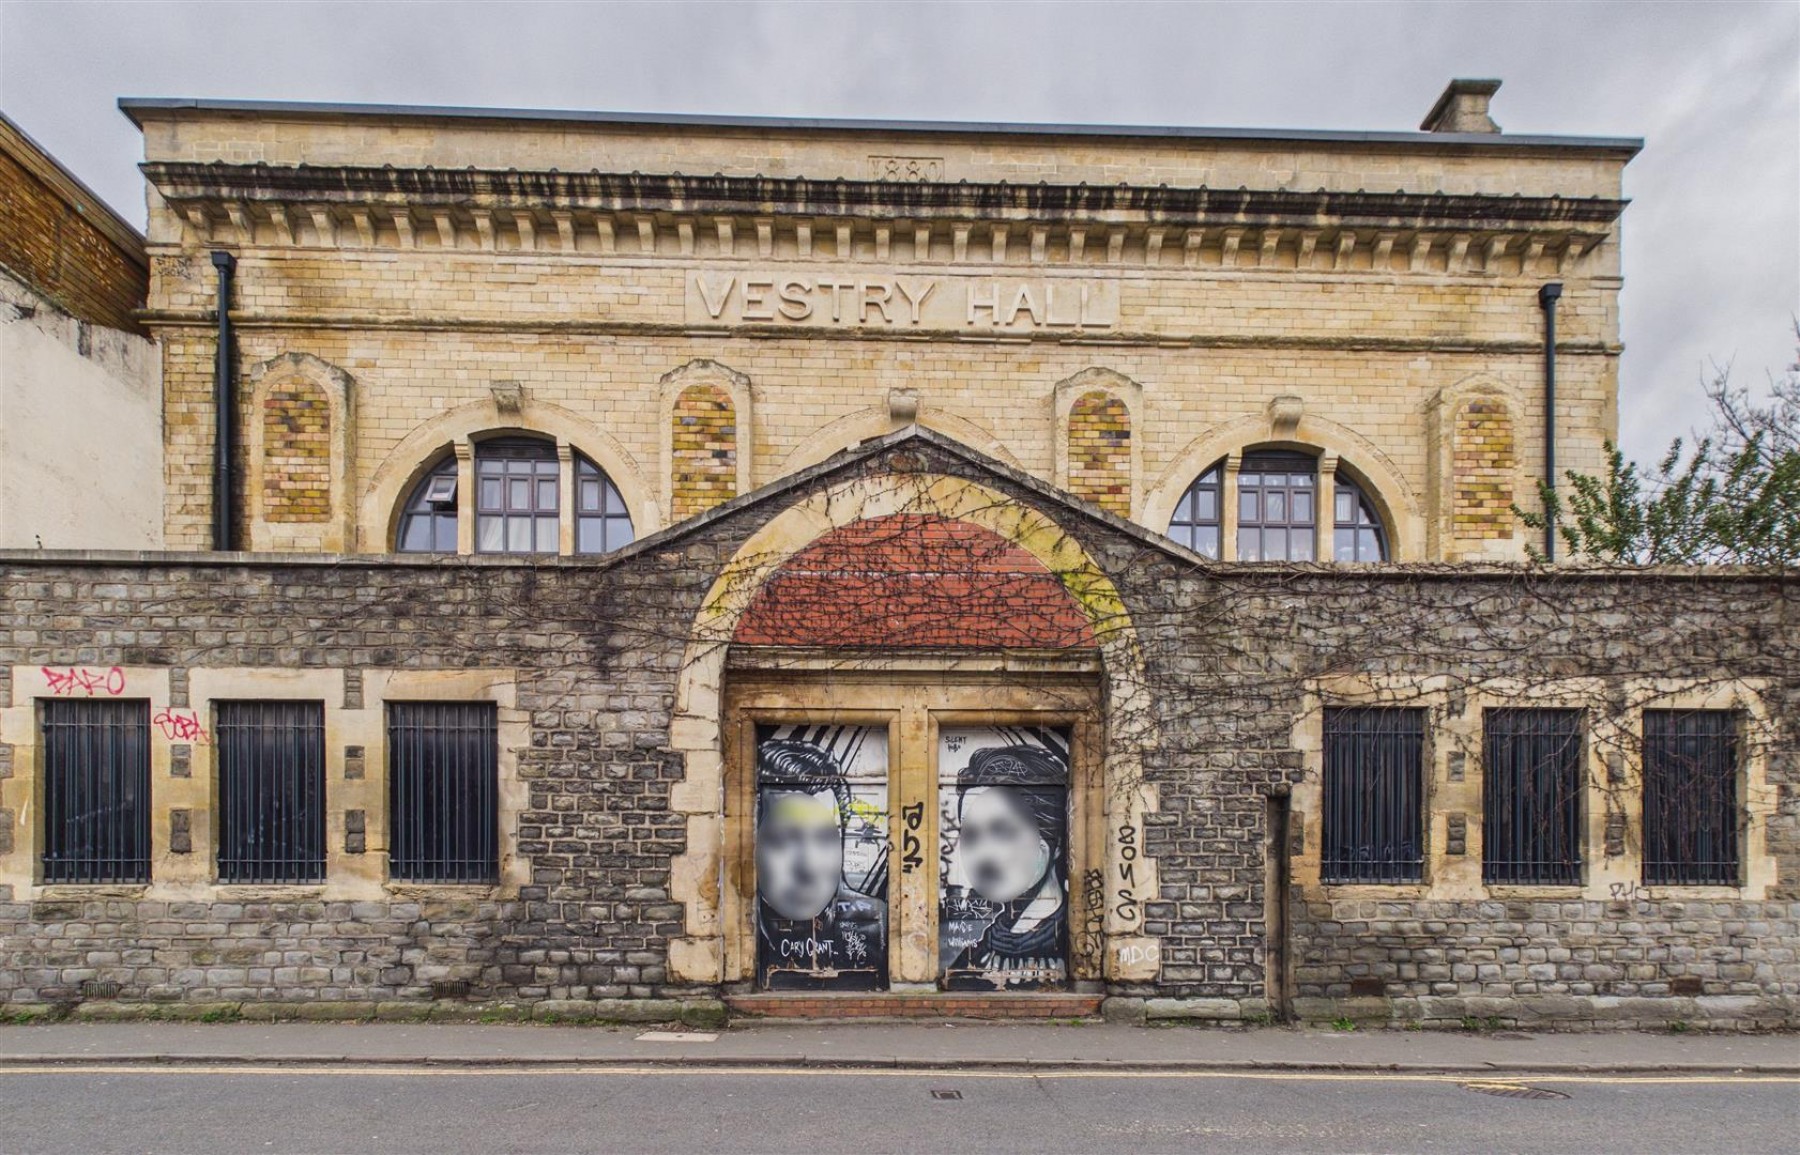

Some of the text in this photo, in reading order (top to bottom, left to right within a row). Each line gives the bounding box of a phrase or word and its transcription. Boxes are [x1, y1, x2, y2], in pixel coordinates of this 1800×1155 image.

[696, 275, 1112, 326] VESTRY HALL
[1119, 946, 1159, 965] MDC
